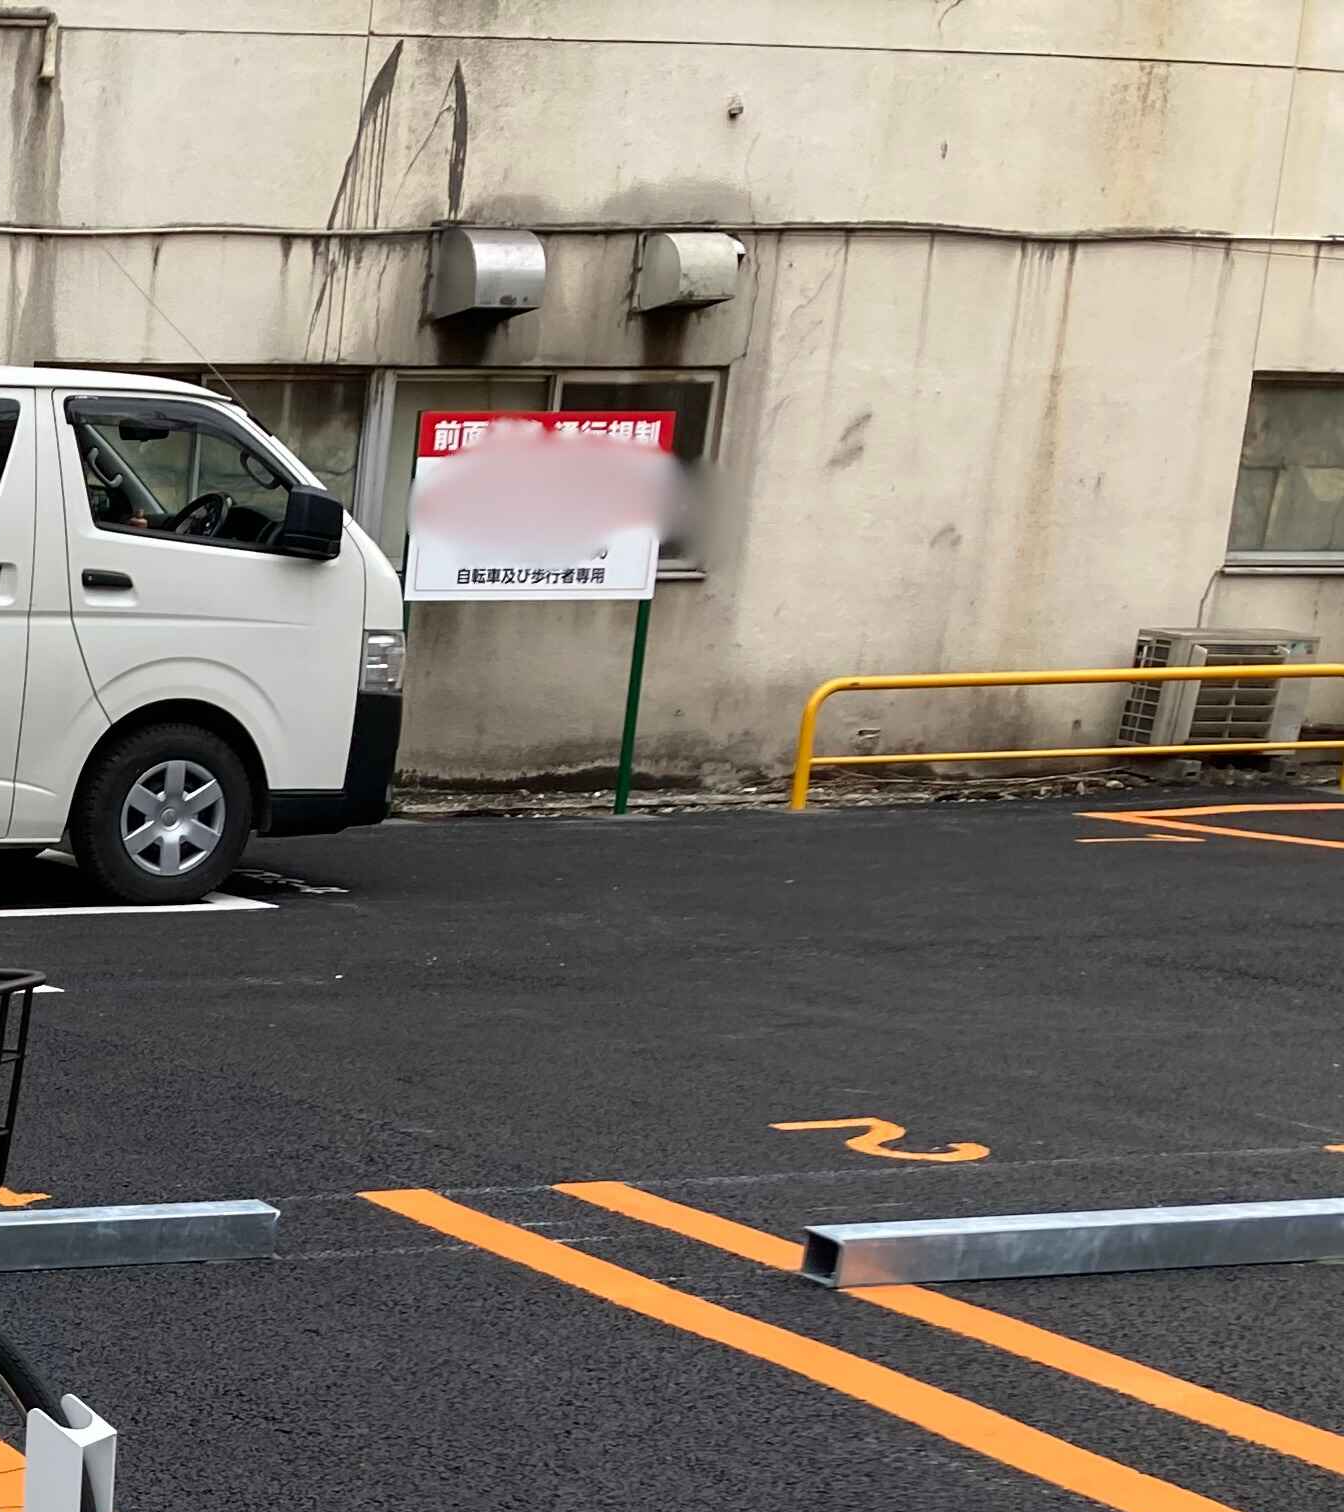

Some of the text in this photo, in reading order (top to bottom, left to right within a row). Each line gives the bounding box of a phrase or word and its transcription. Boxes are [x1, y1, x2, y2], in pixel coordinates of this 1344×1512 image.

[457, 568, 605, 584] 自転車及び歩行者専用
